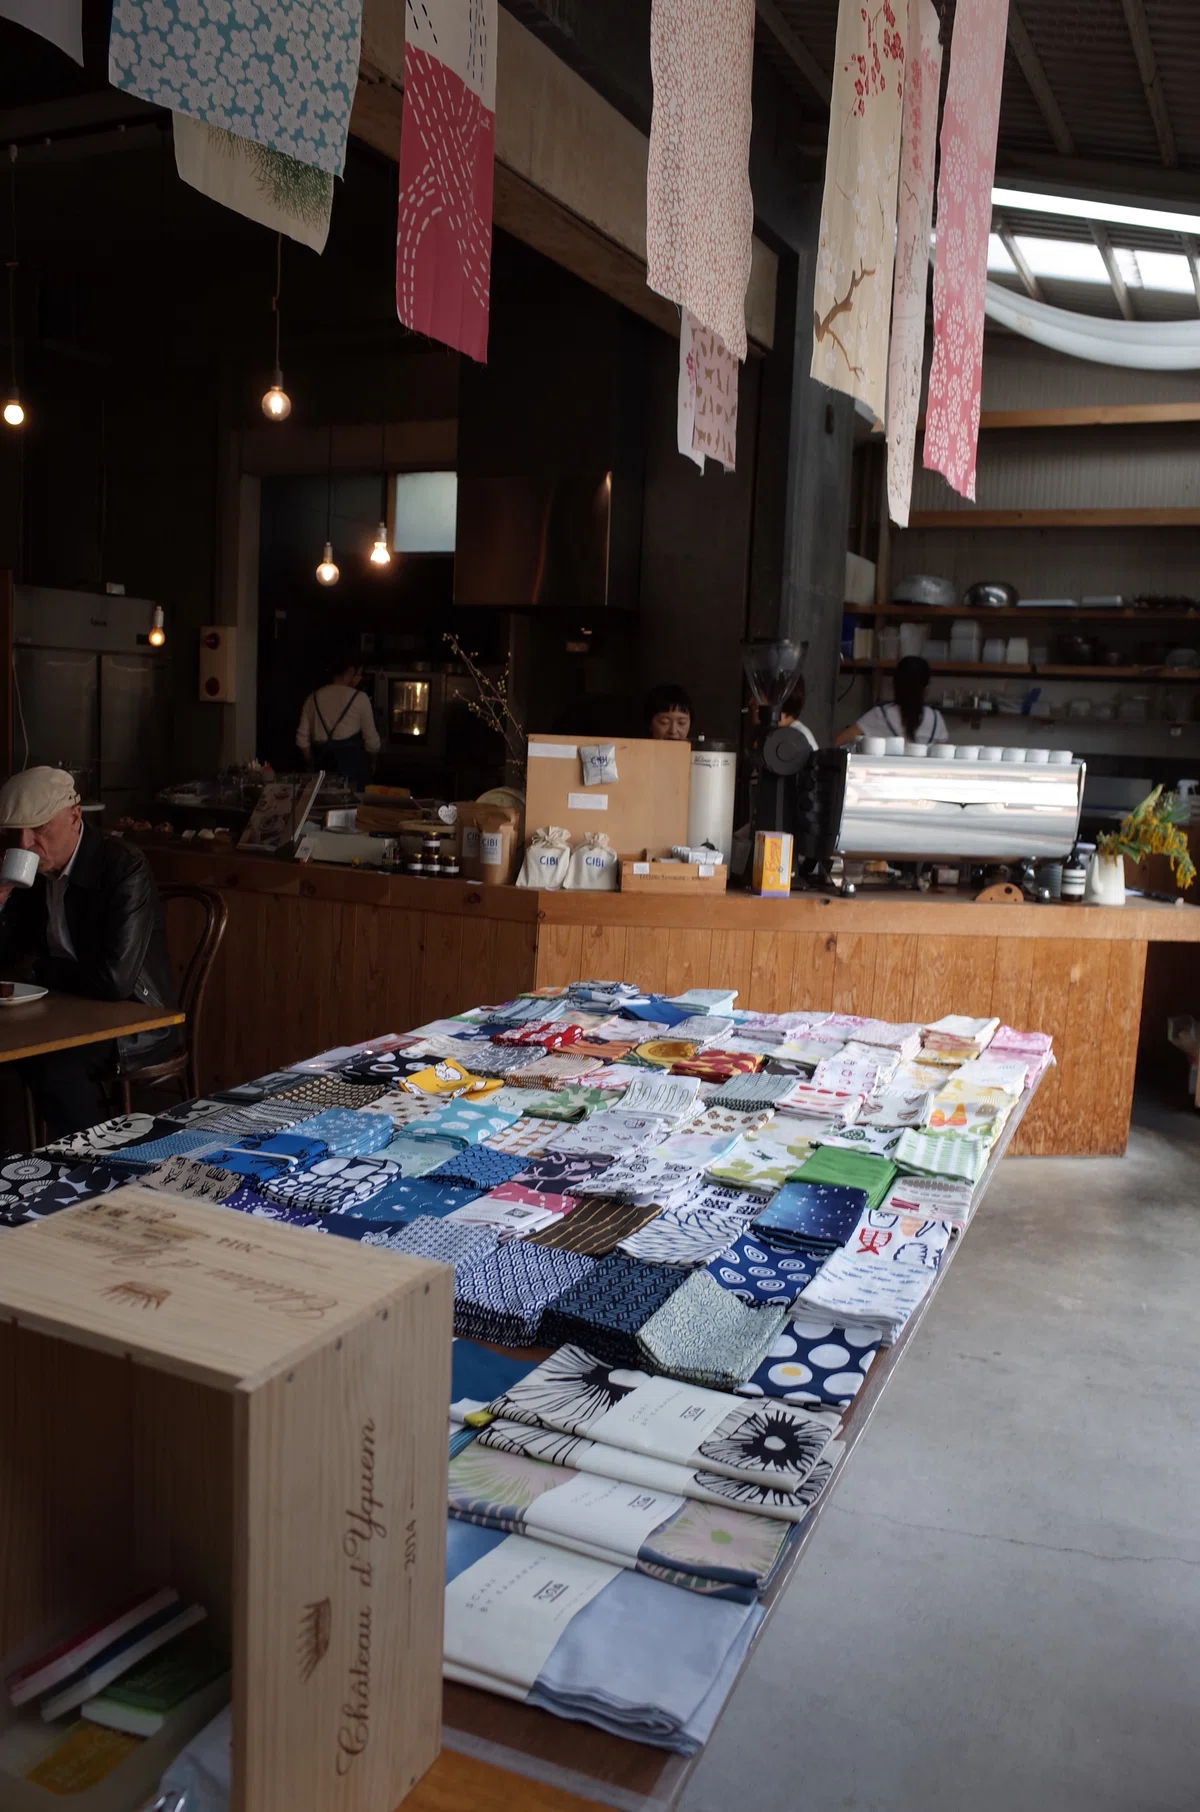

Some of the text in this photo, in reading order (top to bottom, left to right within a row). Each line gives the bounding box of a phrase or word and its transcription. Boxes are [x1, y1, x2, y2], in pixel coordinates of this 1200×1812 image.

[590, 755, 608, 767] CIBI
[481, 837, 498, 848] CIBI
[539, 855, 559, 867] CIBI
[585, 856, 605, 868] CIBI
[404, 1518, 417, 1571] 2014
[336, 1417, 388, 1776] Château d'Yquem
